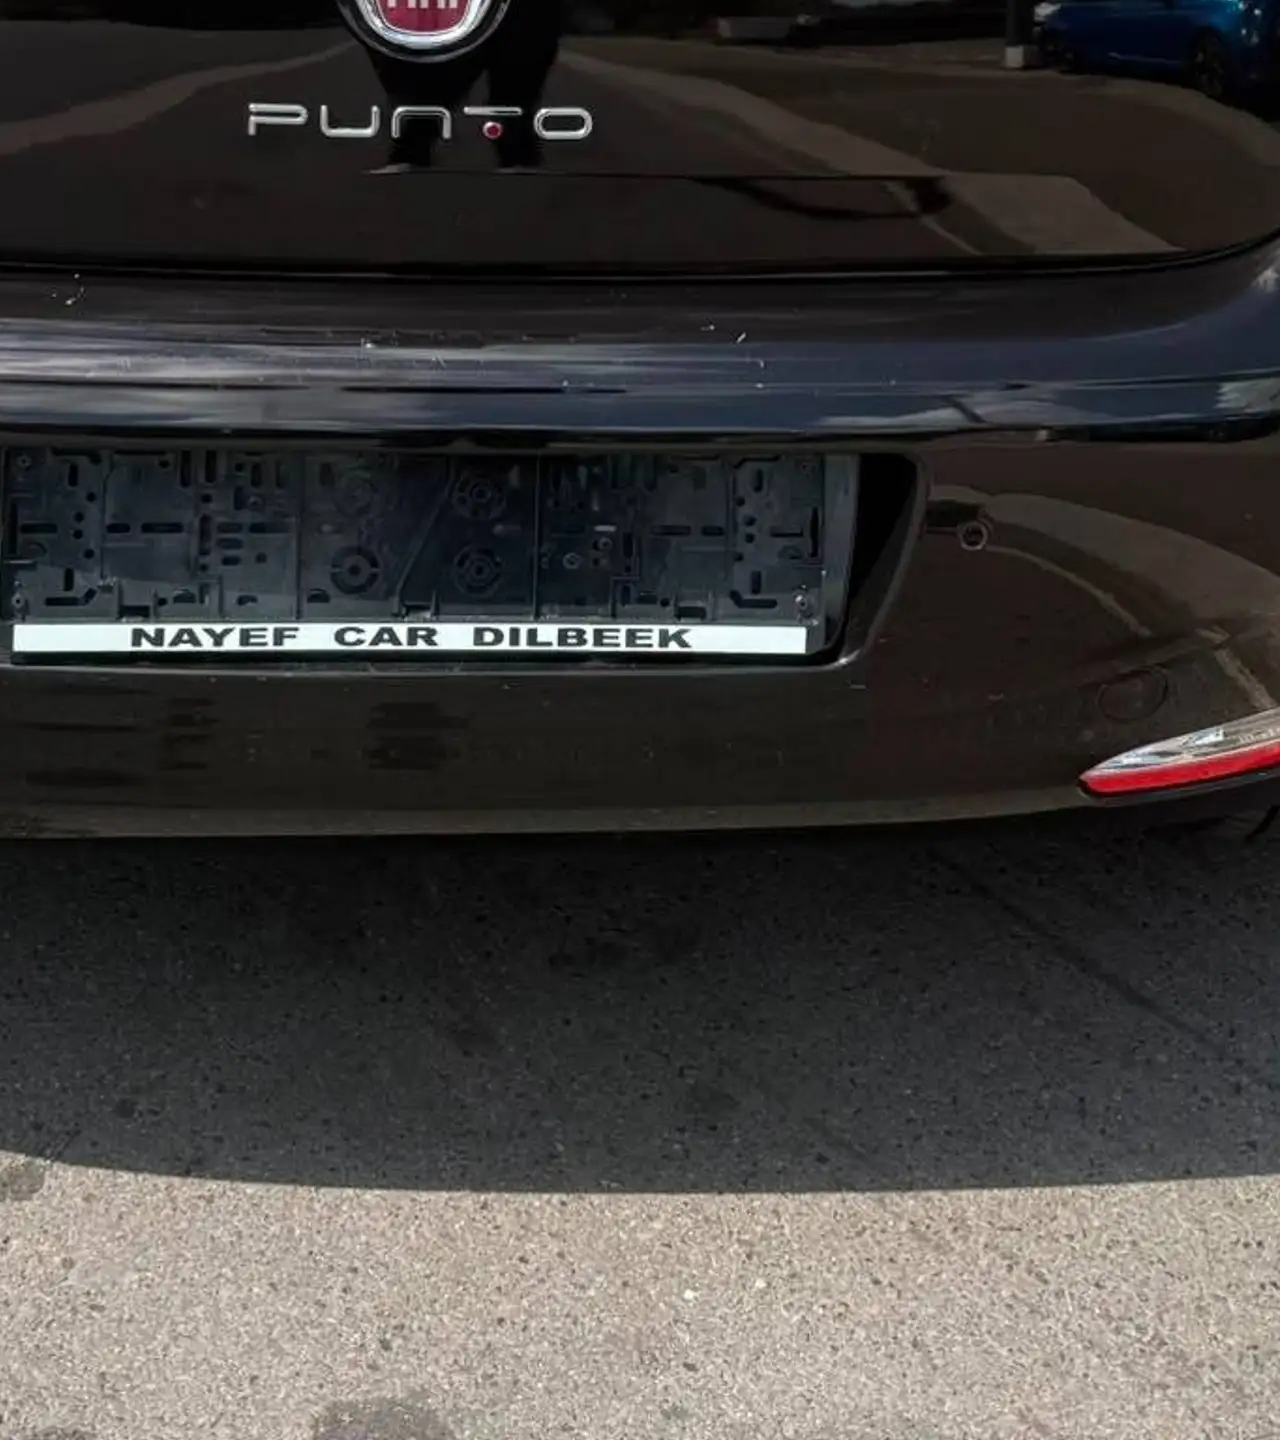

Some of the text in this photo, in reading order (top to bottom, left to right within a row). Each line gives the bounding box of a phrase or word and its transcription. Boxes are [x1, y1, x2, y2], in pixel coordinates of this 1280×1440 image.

[248, 103, 593, 139] PUNTO
[130, 626, 693, 649] NAYEF CAR DILBEEK
